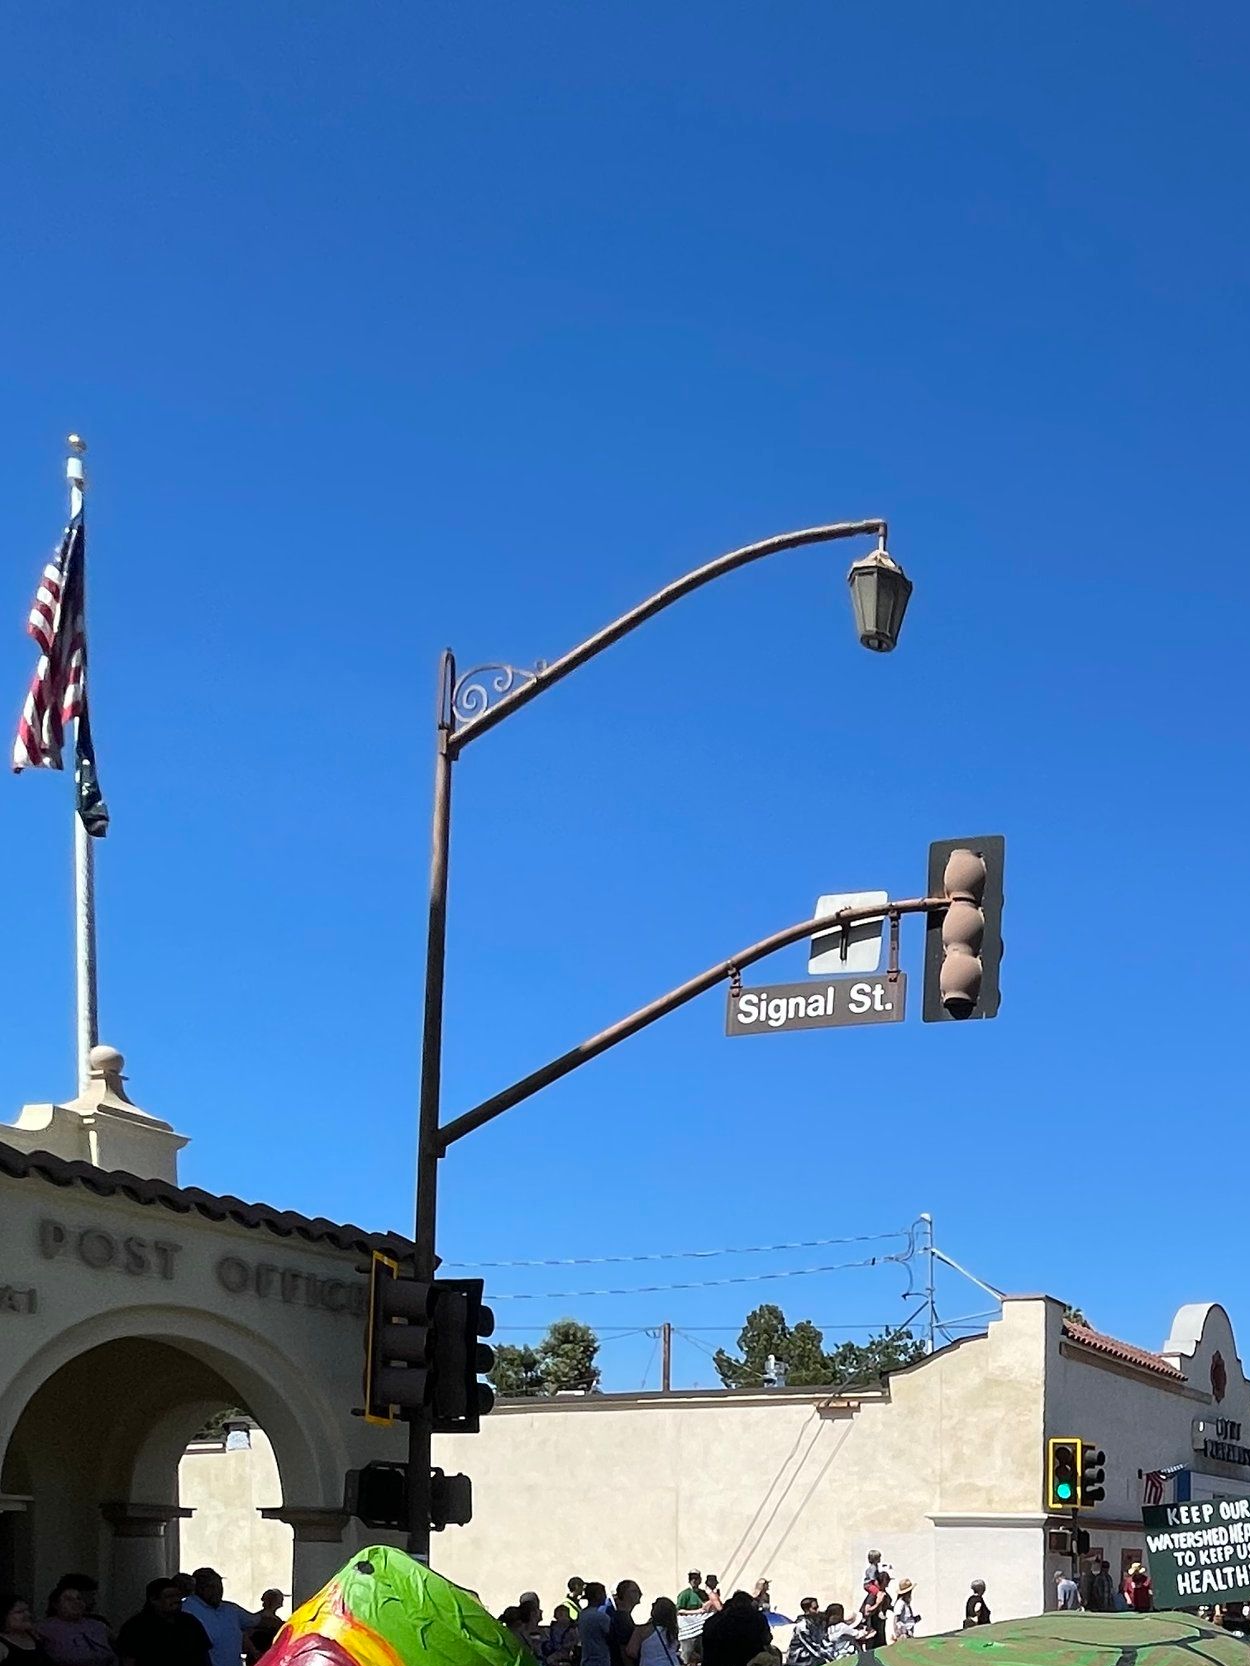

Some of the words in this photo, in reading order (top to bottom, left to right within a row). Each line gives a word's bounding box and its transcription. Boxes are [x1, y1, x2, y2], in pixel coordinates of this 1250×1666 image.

[736, 985, 835, 1027] Signal
[848, 982, 894, 1014] St.
[39, 1218, 183, 1280] POST
[215, 1256, 370, 1320] OFFICE
[1167, 1503, 1214, 1526] KEEP
[1219, 1499, 1250, 1520] OUR
[1146, 1526, 1229, 1553] WATERSHED
[1173, 1551, 1197, 1567] TO
[1199, 1545, 1234, 1566] KEEP
